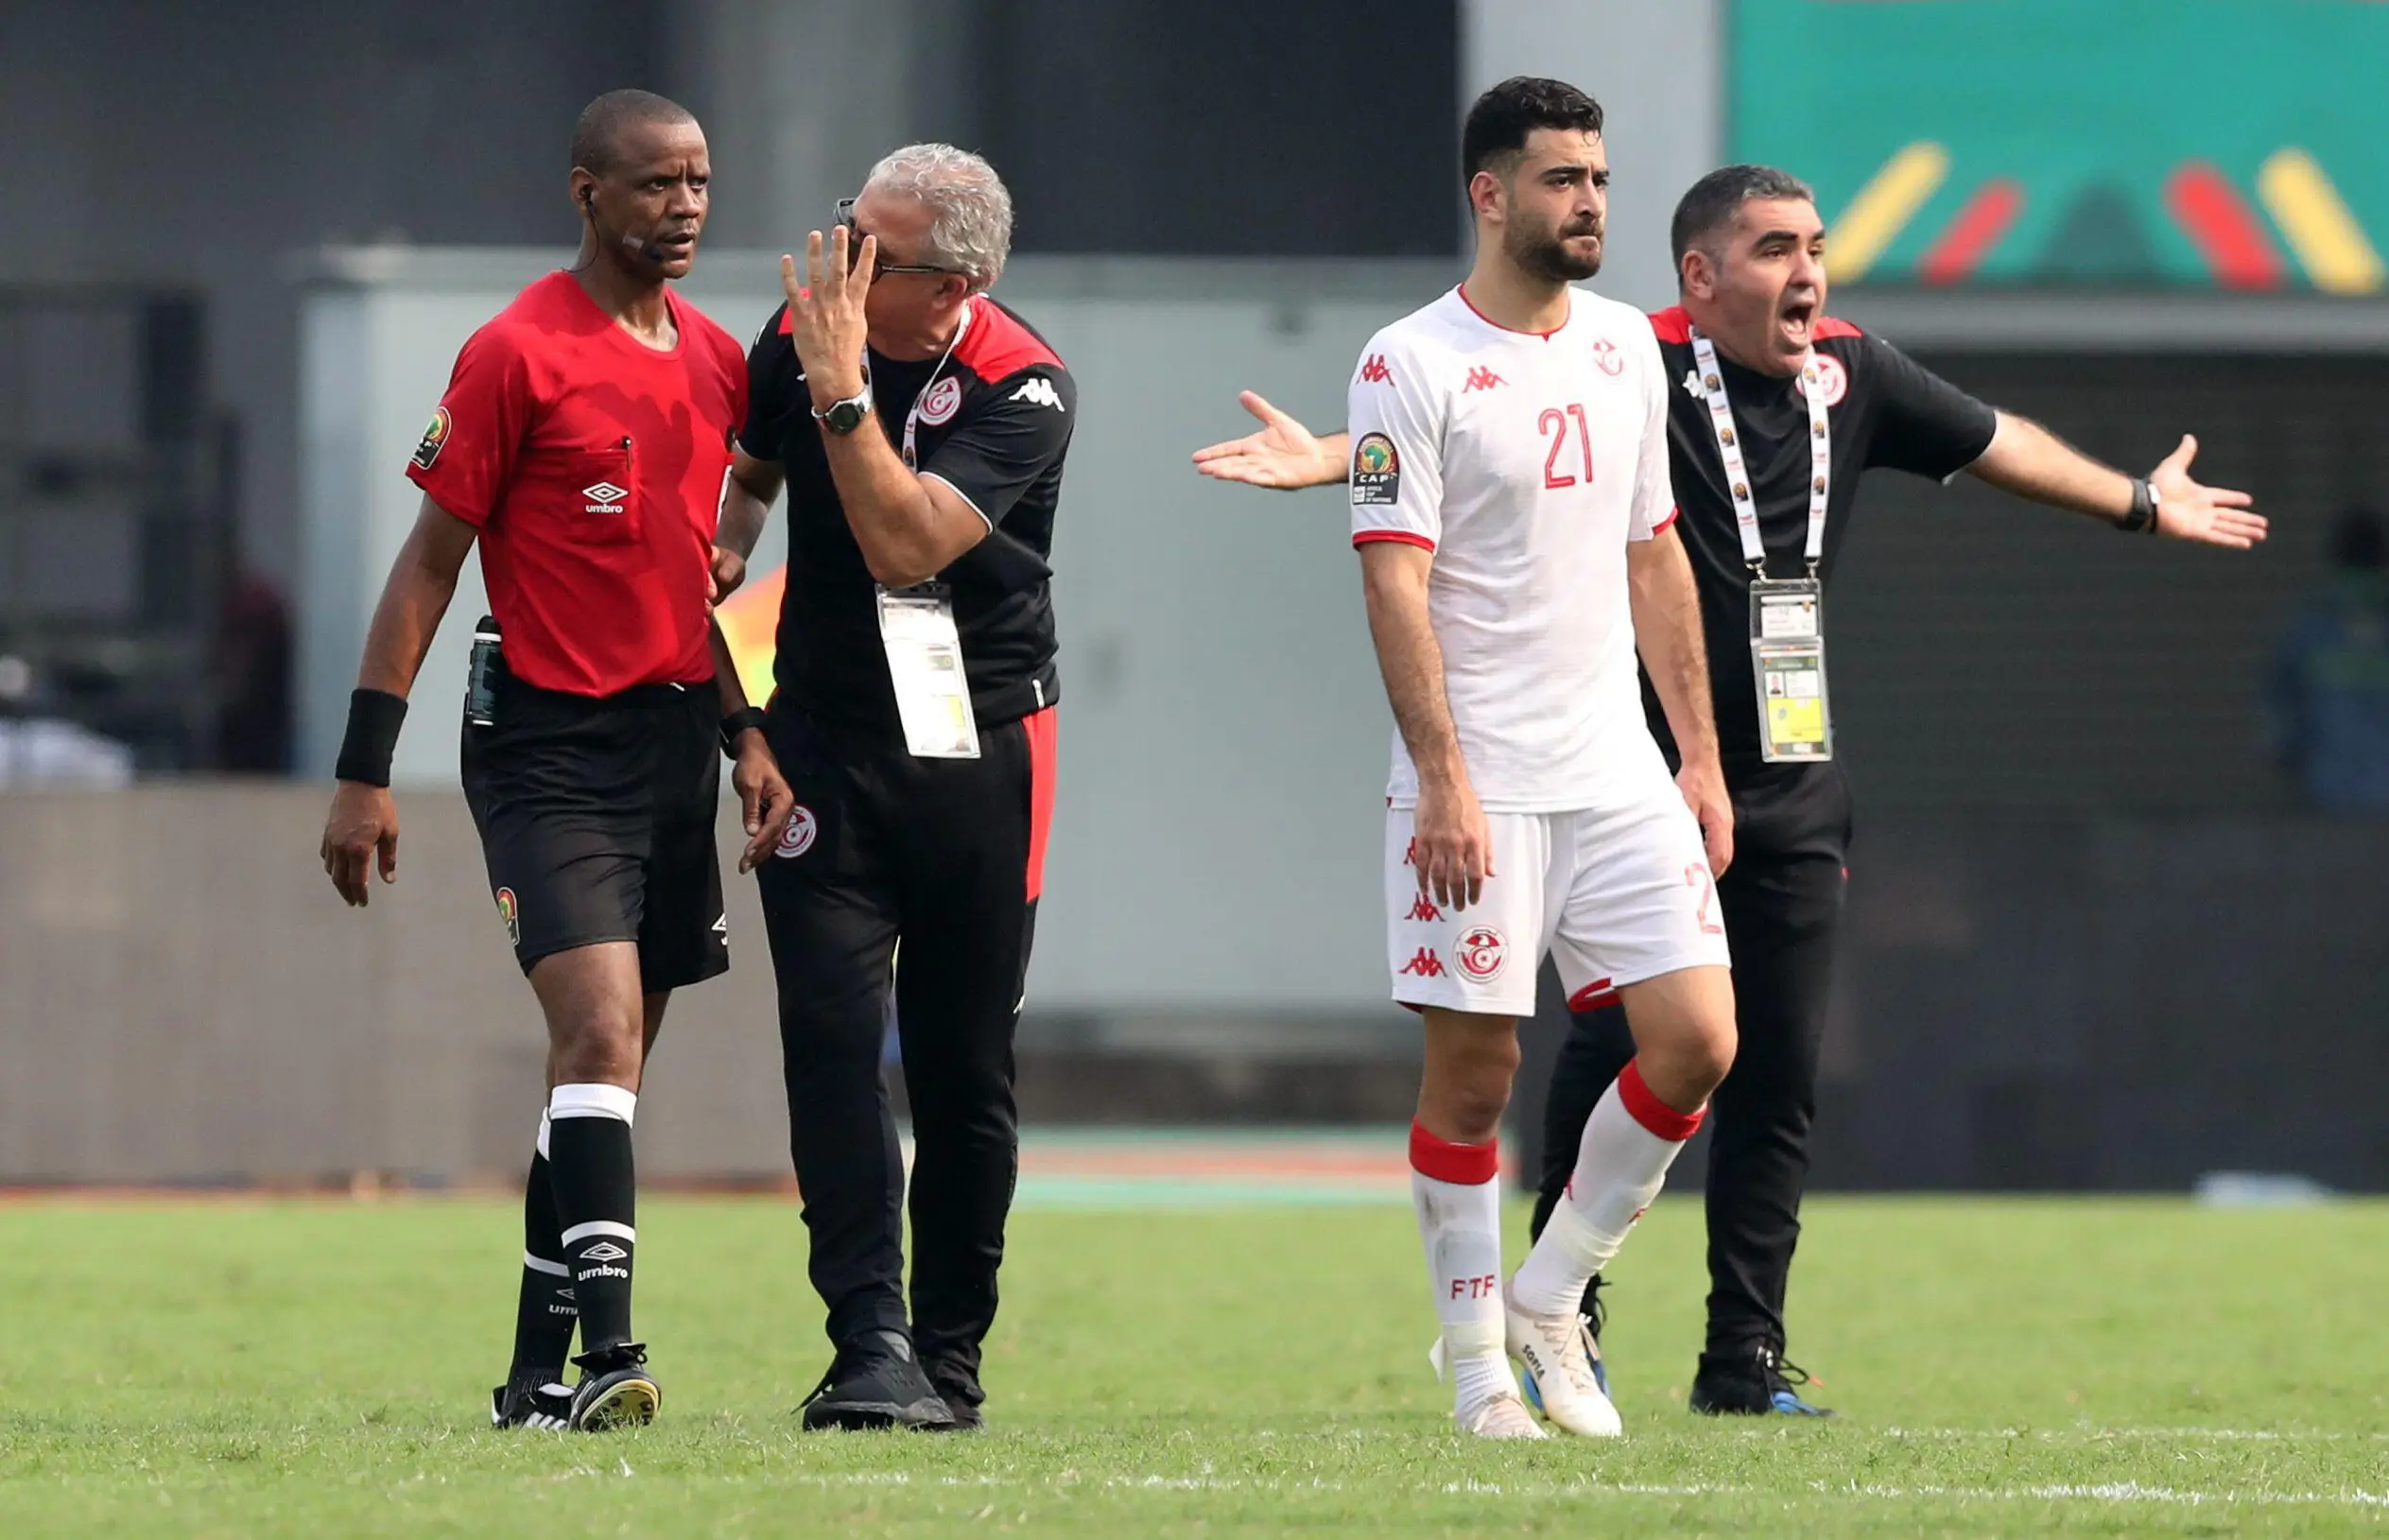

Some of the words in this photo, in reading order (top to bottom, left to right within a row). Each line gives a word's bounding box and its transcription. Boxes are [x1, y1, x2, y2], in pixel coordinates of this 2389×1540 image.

[1538, 403, 1592, 489] 21
[586, 503, 624, 513] umbro
[1685, 862, 1723, 934] 2
[578, 1264, 628, 1281] umbro
[1451, 1274, 1495, 1300] FTF
[1522, 1343, 1545, 1380] SOFIA
